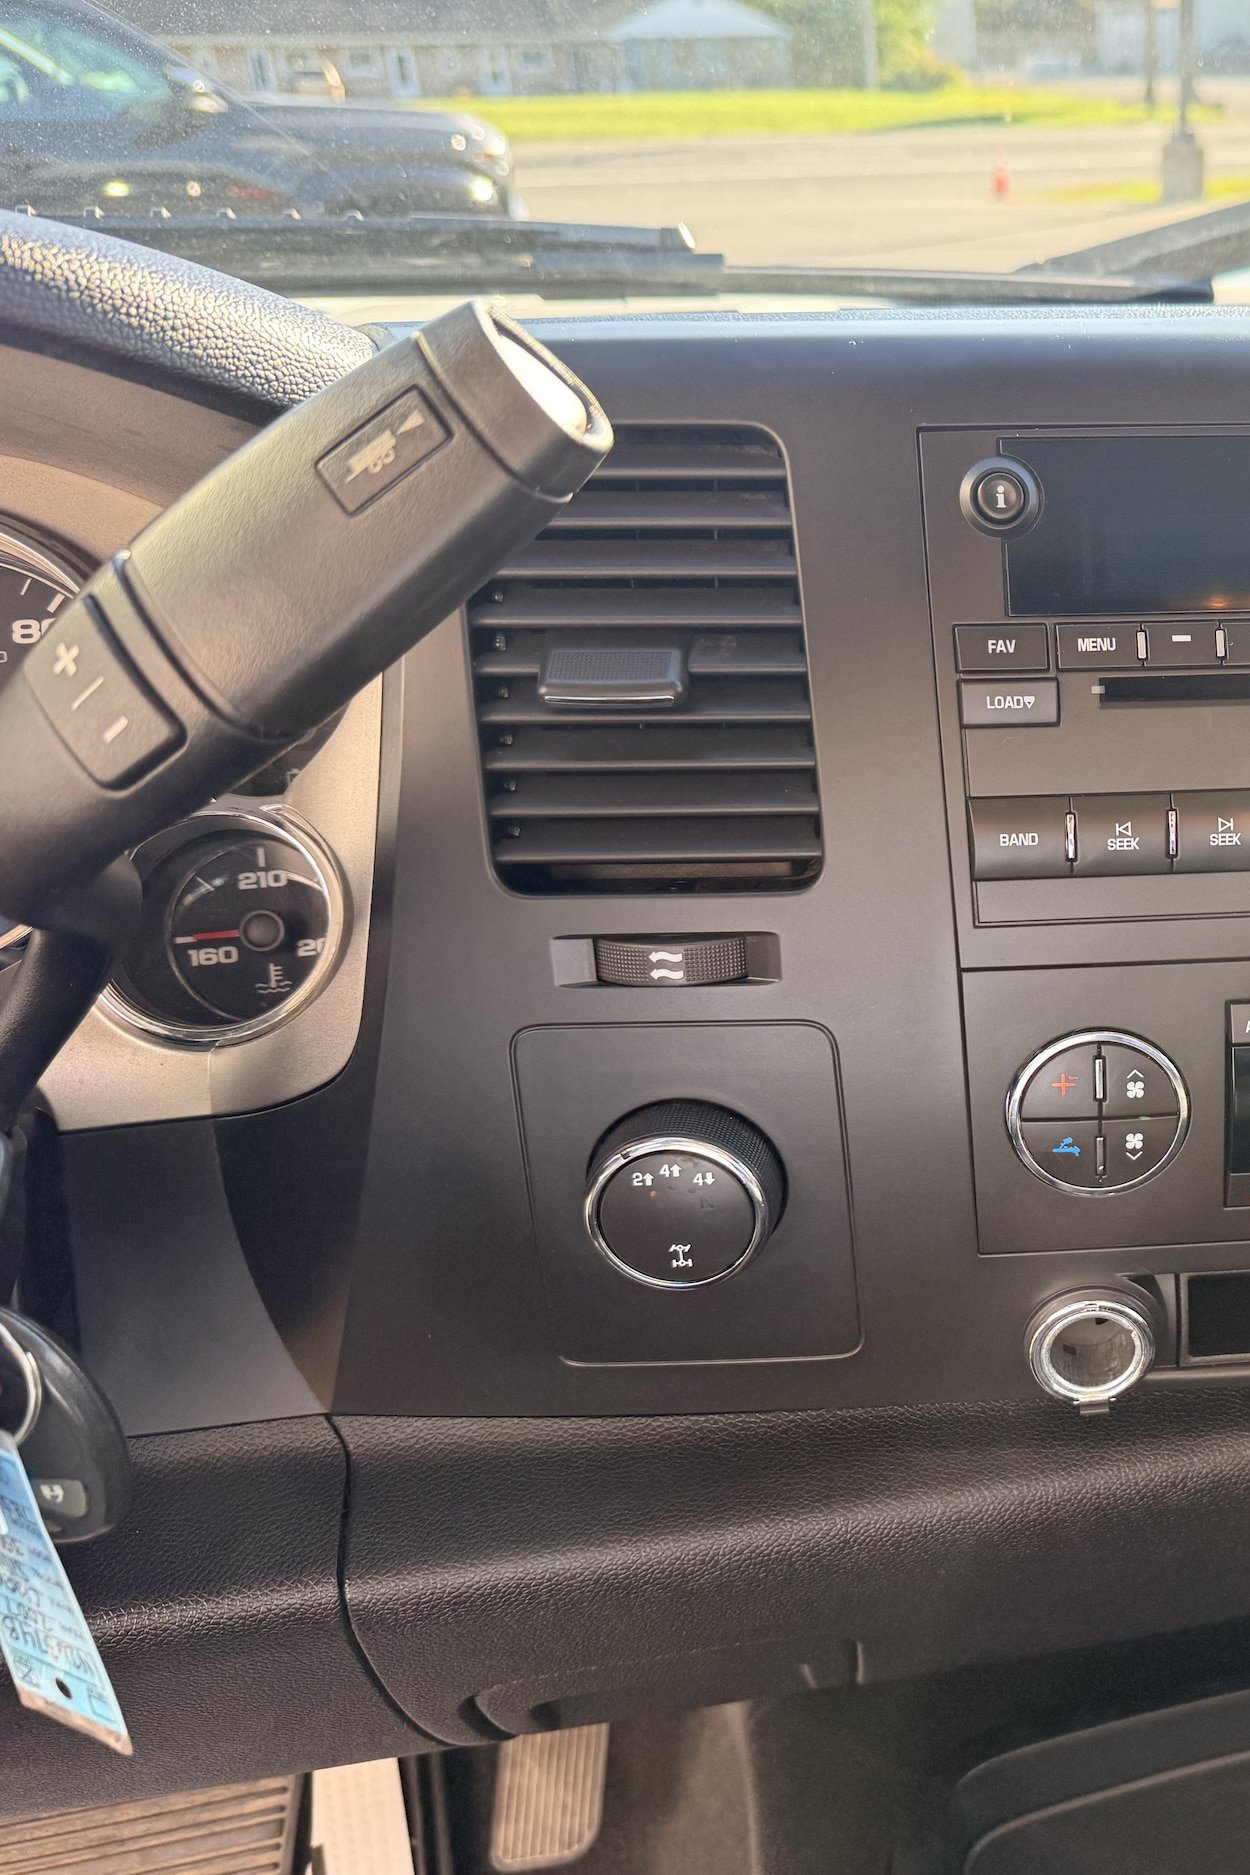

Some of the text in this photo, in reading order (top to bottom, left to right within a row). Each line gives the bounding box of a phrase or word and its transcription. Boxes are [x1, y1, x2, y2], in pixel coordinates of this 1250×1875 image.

[987, 639, 1016, 654] FAV
[1077, 637, 1117, 652] MENU
[986, 696, 1023, 709] LOAD
[1000, 833, 1039, 848] BAND
[1107, 837, 1140, 852] SEEK
[1209, 833, 1242, 847] SEEK
[238, 870, 289, 890] 210
[187, 946, 239, 966] 160
